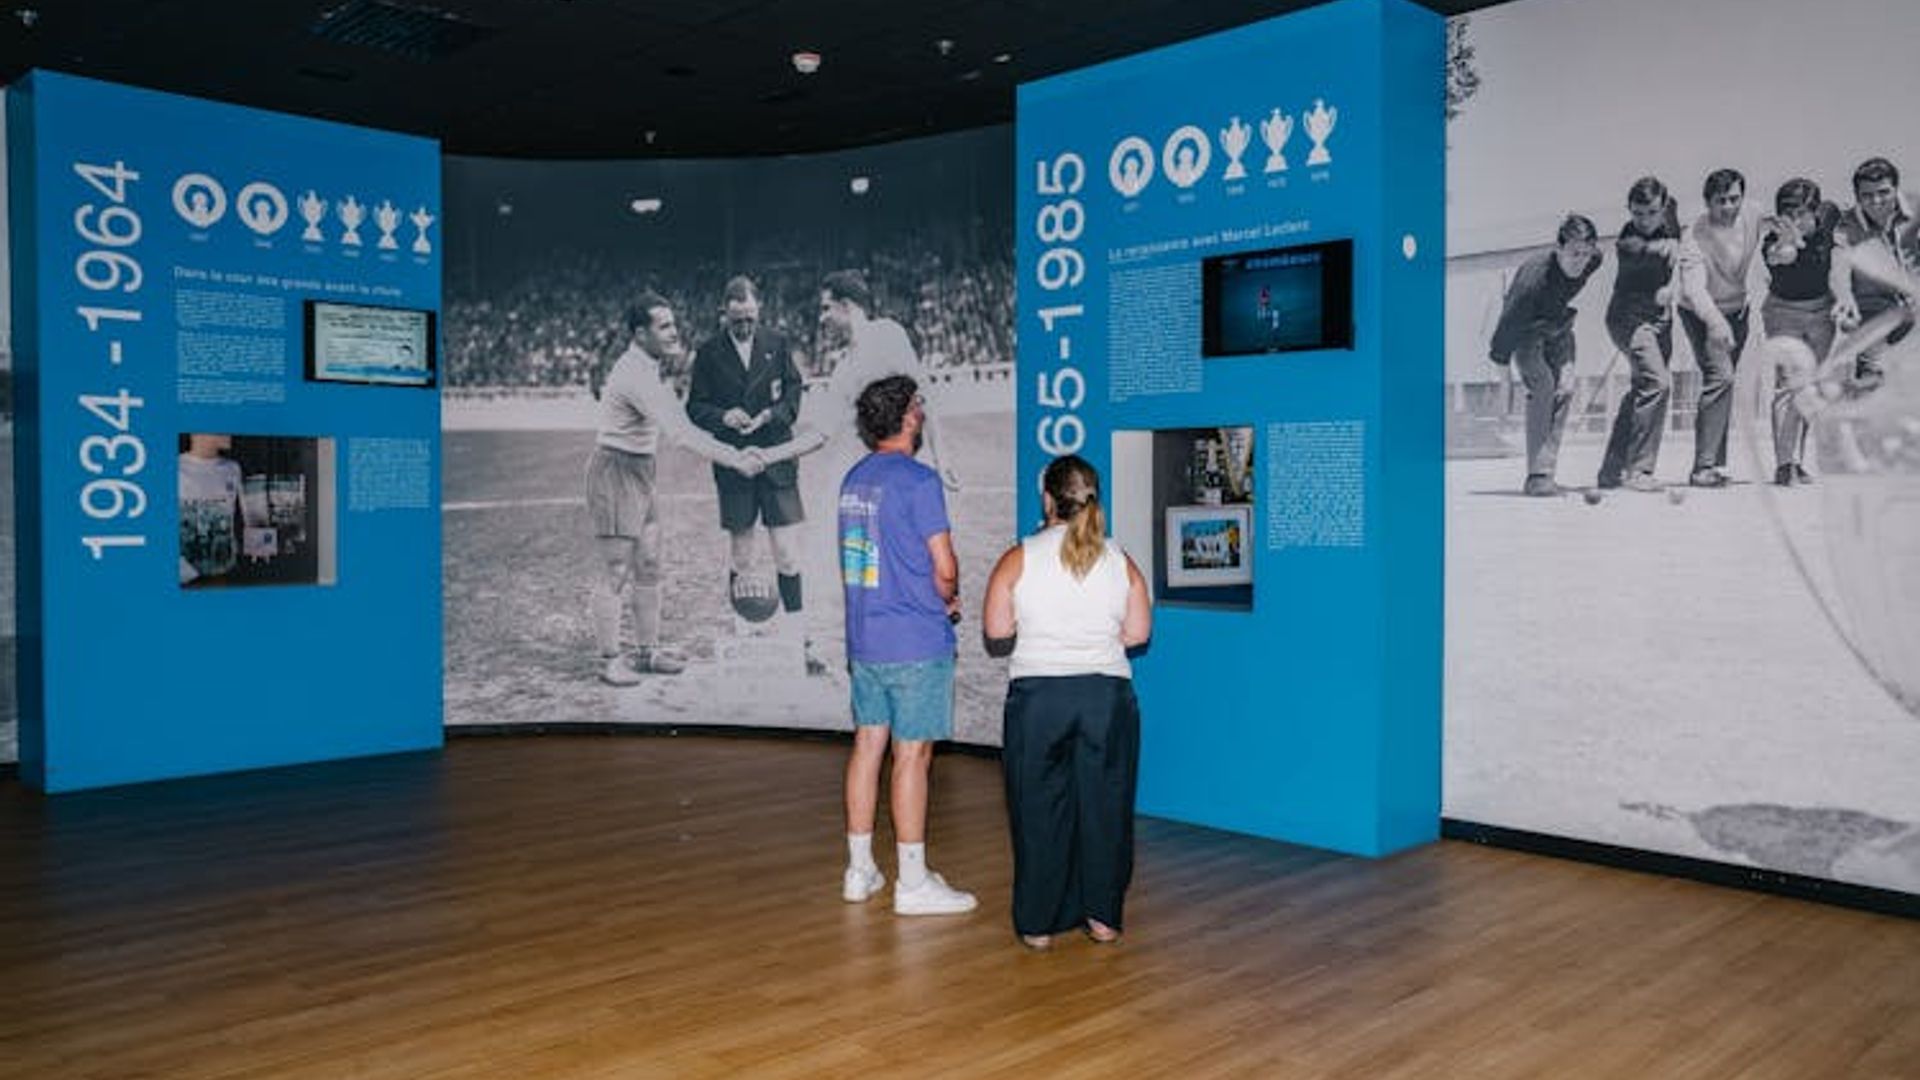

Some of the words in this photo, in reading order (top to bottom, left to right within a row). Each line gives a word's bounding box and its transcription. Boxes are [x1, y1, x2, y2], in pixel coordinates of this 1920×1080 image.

[1221, 224, 1262, 243] Marcel
[1037, 153, 1086, 527] 65-1985
[78, 388, 148, 560] 1934
